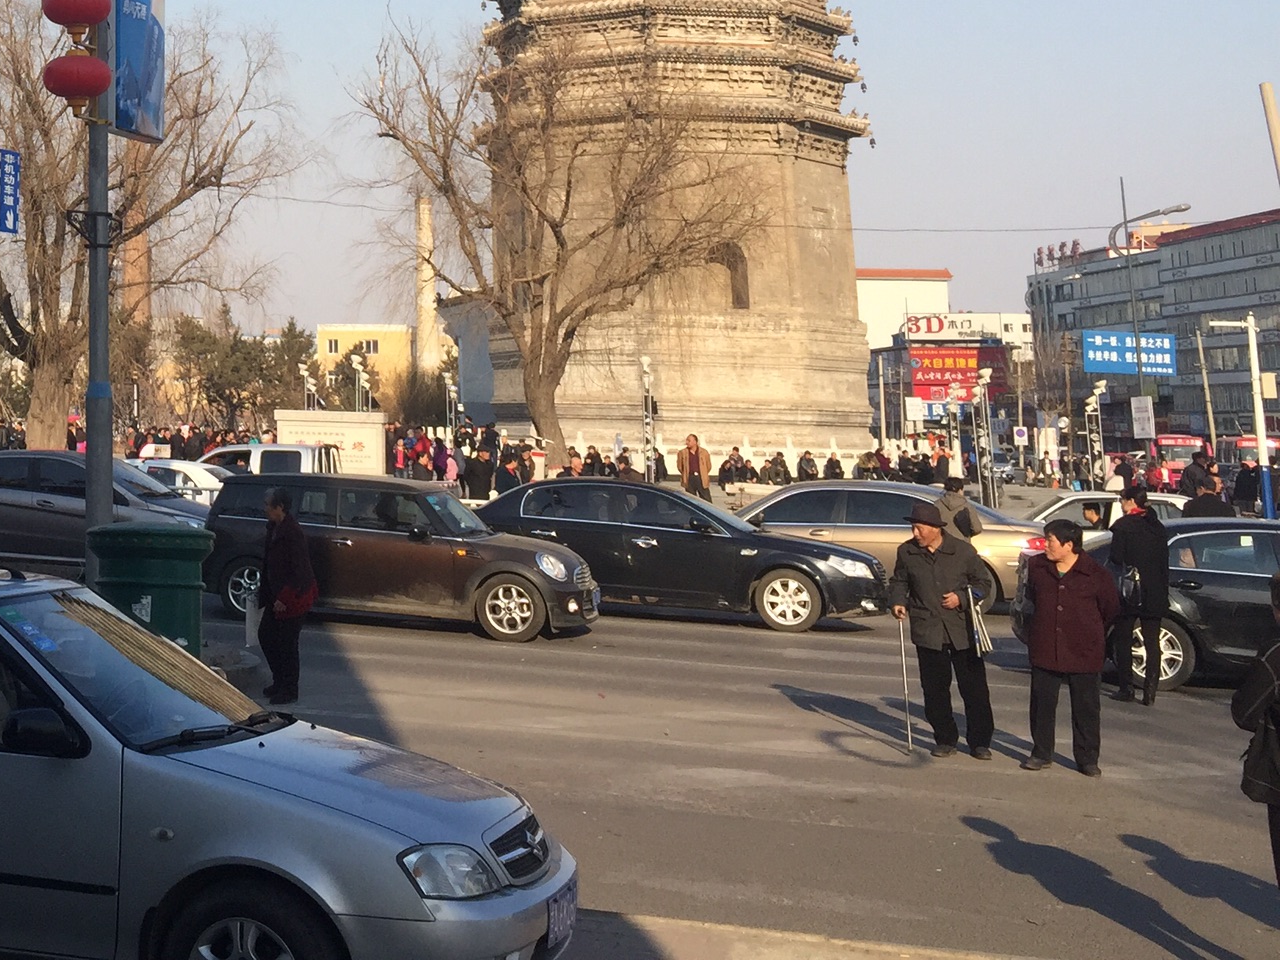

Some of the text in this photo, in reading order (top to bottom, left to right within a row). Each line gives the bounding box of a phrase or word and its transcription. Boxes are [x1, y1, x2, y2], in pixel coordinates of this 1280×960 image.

[4, 154, 15, 206] 非机动车道
